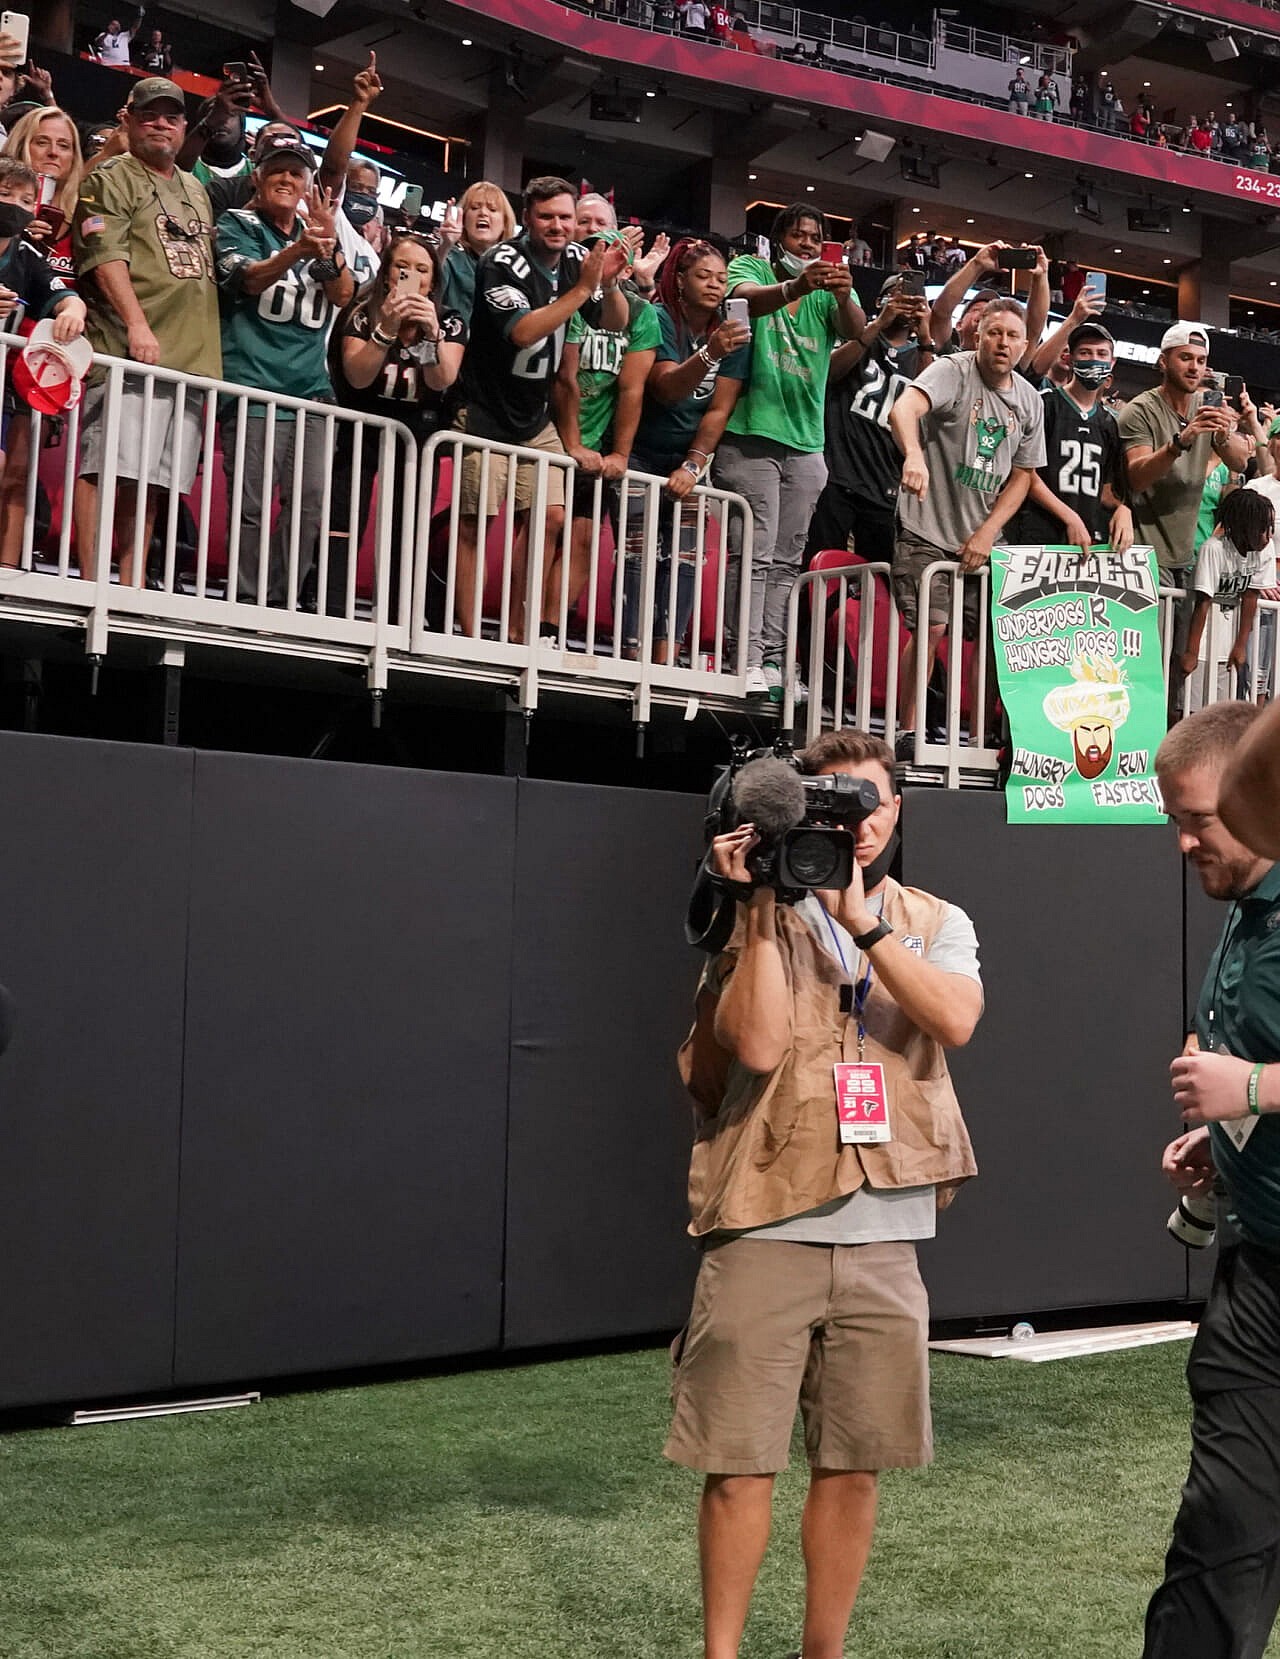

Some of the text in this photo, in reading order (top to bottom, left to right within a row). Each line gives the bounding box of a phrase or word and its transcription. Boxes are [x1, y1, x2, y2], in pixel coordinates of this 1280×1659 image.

[493, 244, 532, 280] 20
[383, 363, 417, 402] 11
[981, 435, 995, 449] 92
[1059, 439, 1103, 498] 25
[999, 545, 1158, 606] EAGLES
[996, 597, 1111, 642] UNDERDOGS R
[1005, 630, 1143, 674] HUNGRY DOGS !!!
[1013, 748, 1148, 784] HUNGRY RUN
[1024, 785, 1065, 811] DOGS
[1248, 1073, 1259, 1106] EAGLES
